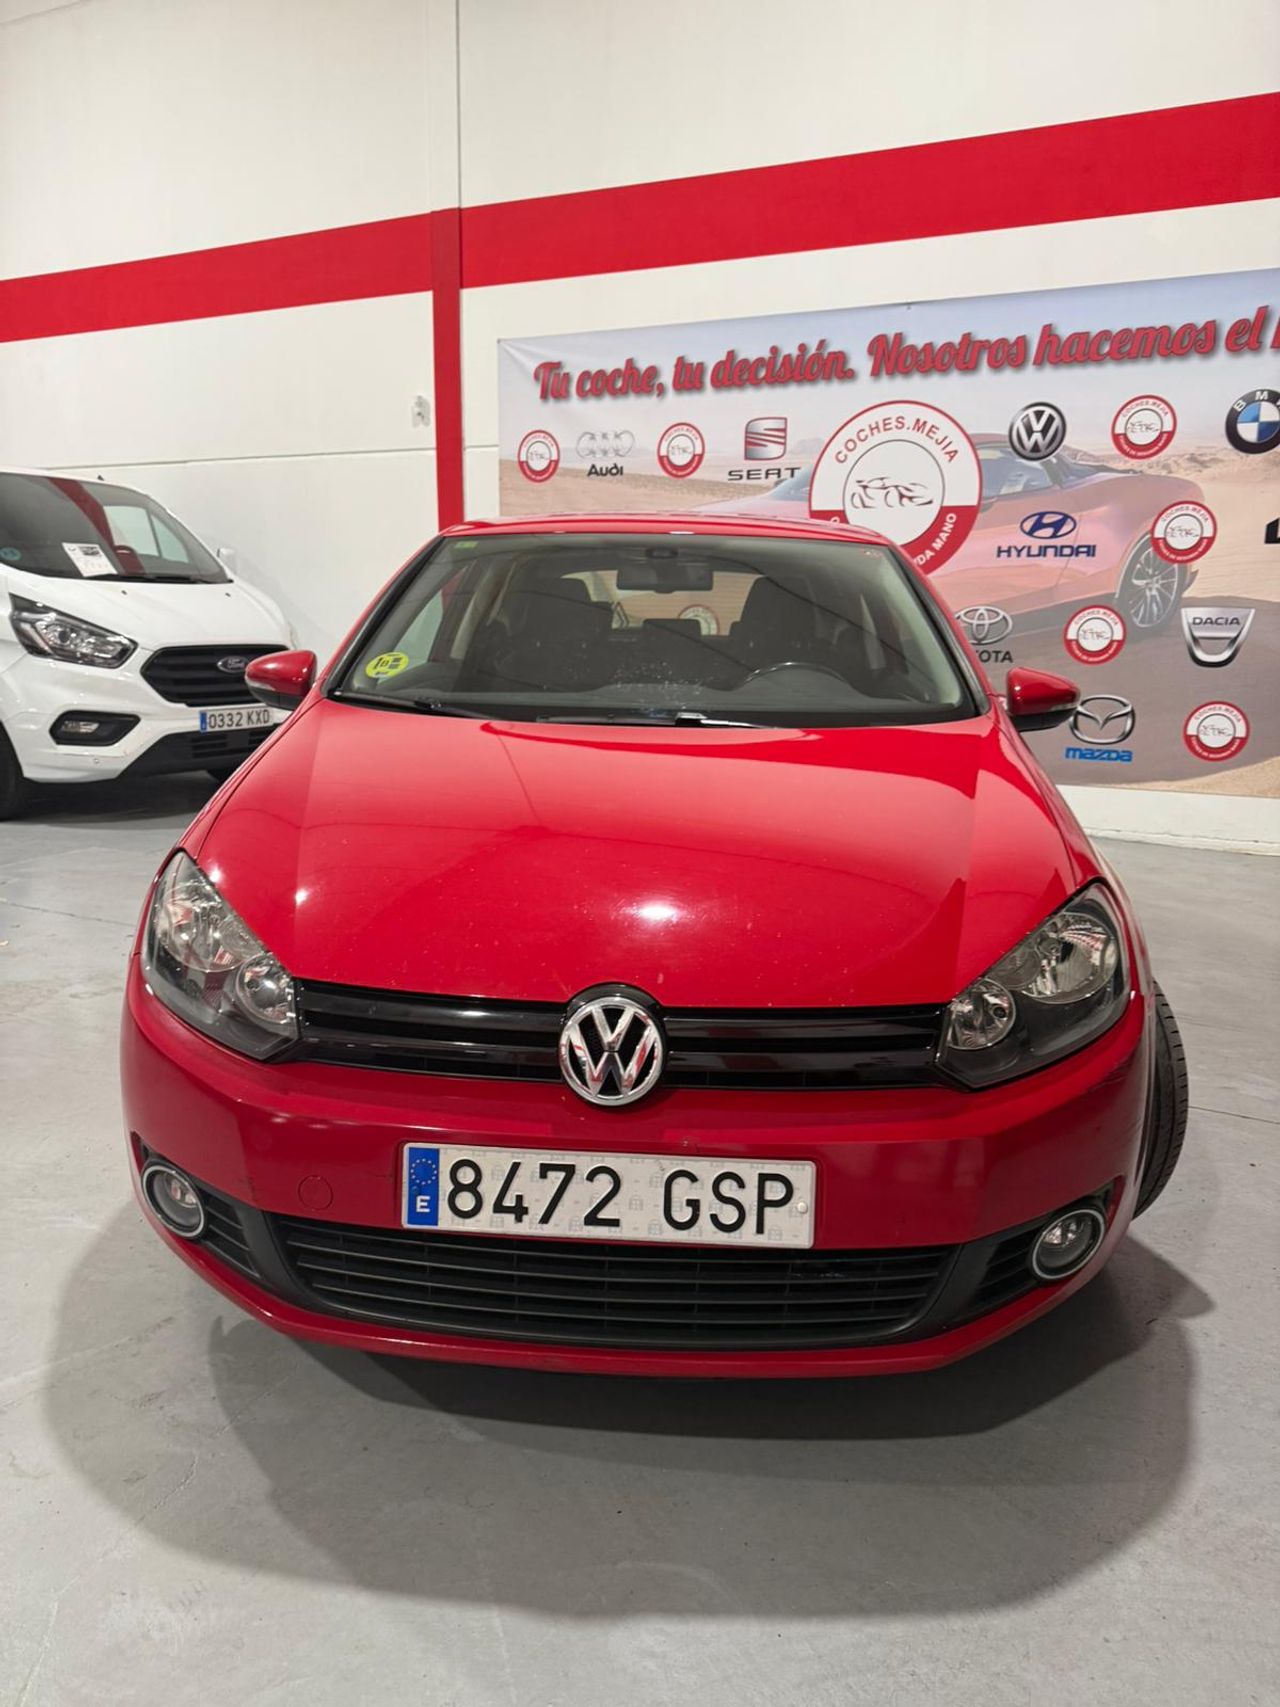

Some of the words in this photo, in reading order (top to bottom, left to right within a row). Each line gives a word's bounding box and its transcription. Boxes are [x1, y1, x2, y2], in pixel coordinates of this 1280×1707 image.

[533, 361, 569, 400] Tu
[575, 358, 664, 398] coche,
[672, 355, 705, 391] tu
[710, 339, 855, 388] decisión.
[867, 331, 1025, 377] Nosotros
[1033, 319, 1216, 367] hacemos
[1225, 304, 1269, 352] el
[834, 416, 959, 464] COCHES.MEJIA
[587, 463, 624, 477] Audi
[728, 467, 800, 481] SEAT
[932, 512, 957, 551] MANO
[996, 545, 1096, 559] HYUNDAI
[1192, 616, 1241, 627] DACIA
[975, 650, 1014, 664] OTA
[208, 712, 244, 729] 0332
[247, 709, 270, 726] KXD
[1065, 747, 1133, 763] mazda
[416, 1195, 430, 1213] E
[446, 1158, 622, 1227] 8472
[662, 1169, 794, 1235] GSP
